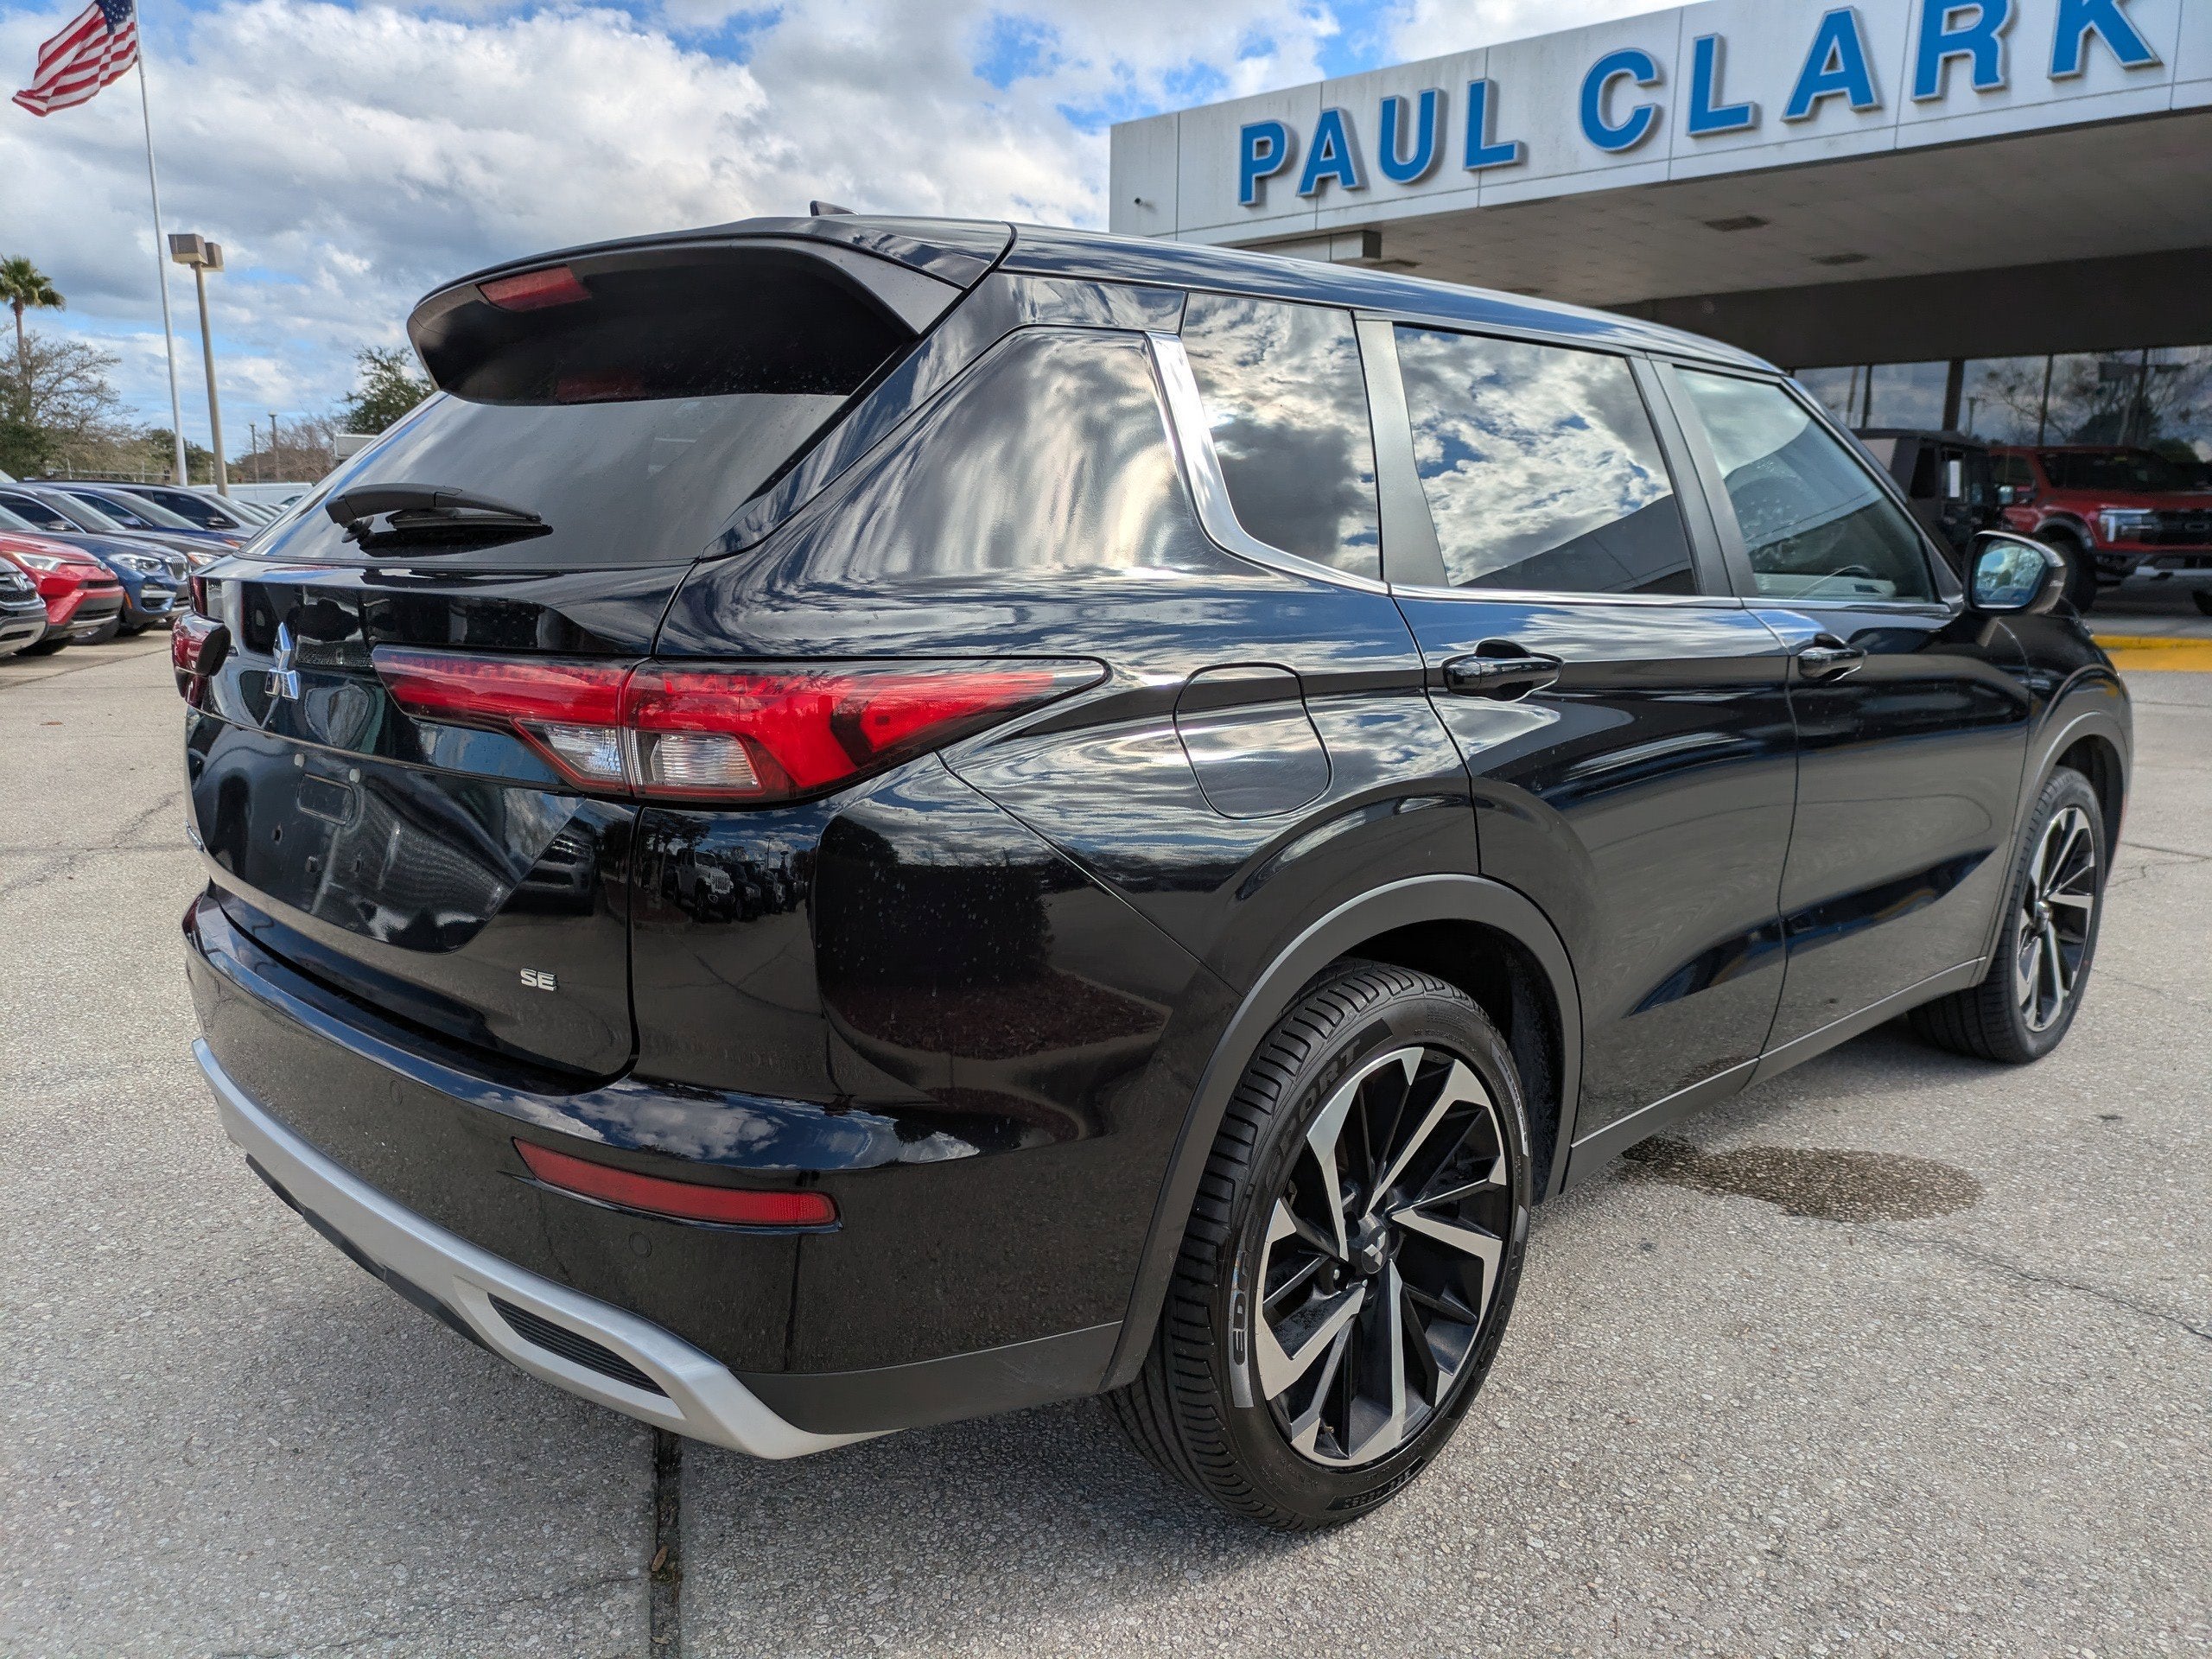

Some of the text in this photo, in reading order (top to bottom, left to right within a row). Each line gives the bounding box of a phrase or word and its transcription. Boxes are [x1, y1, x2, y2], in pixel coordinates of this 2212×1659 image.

[1237, 0, 2164, 207] PAUL CLARK
[520, 968, 557, 992] SE
